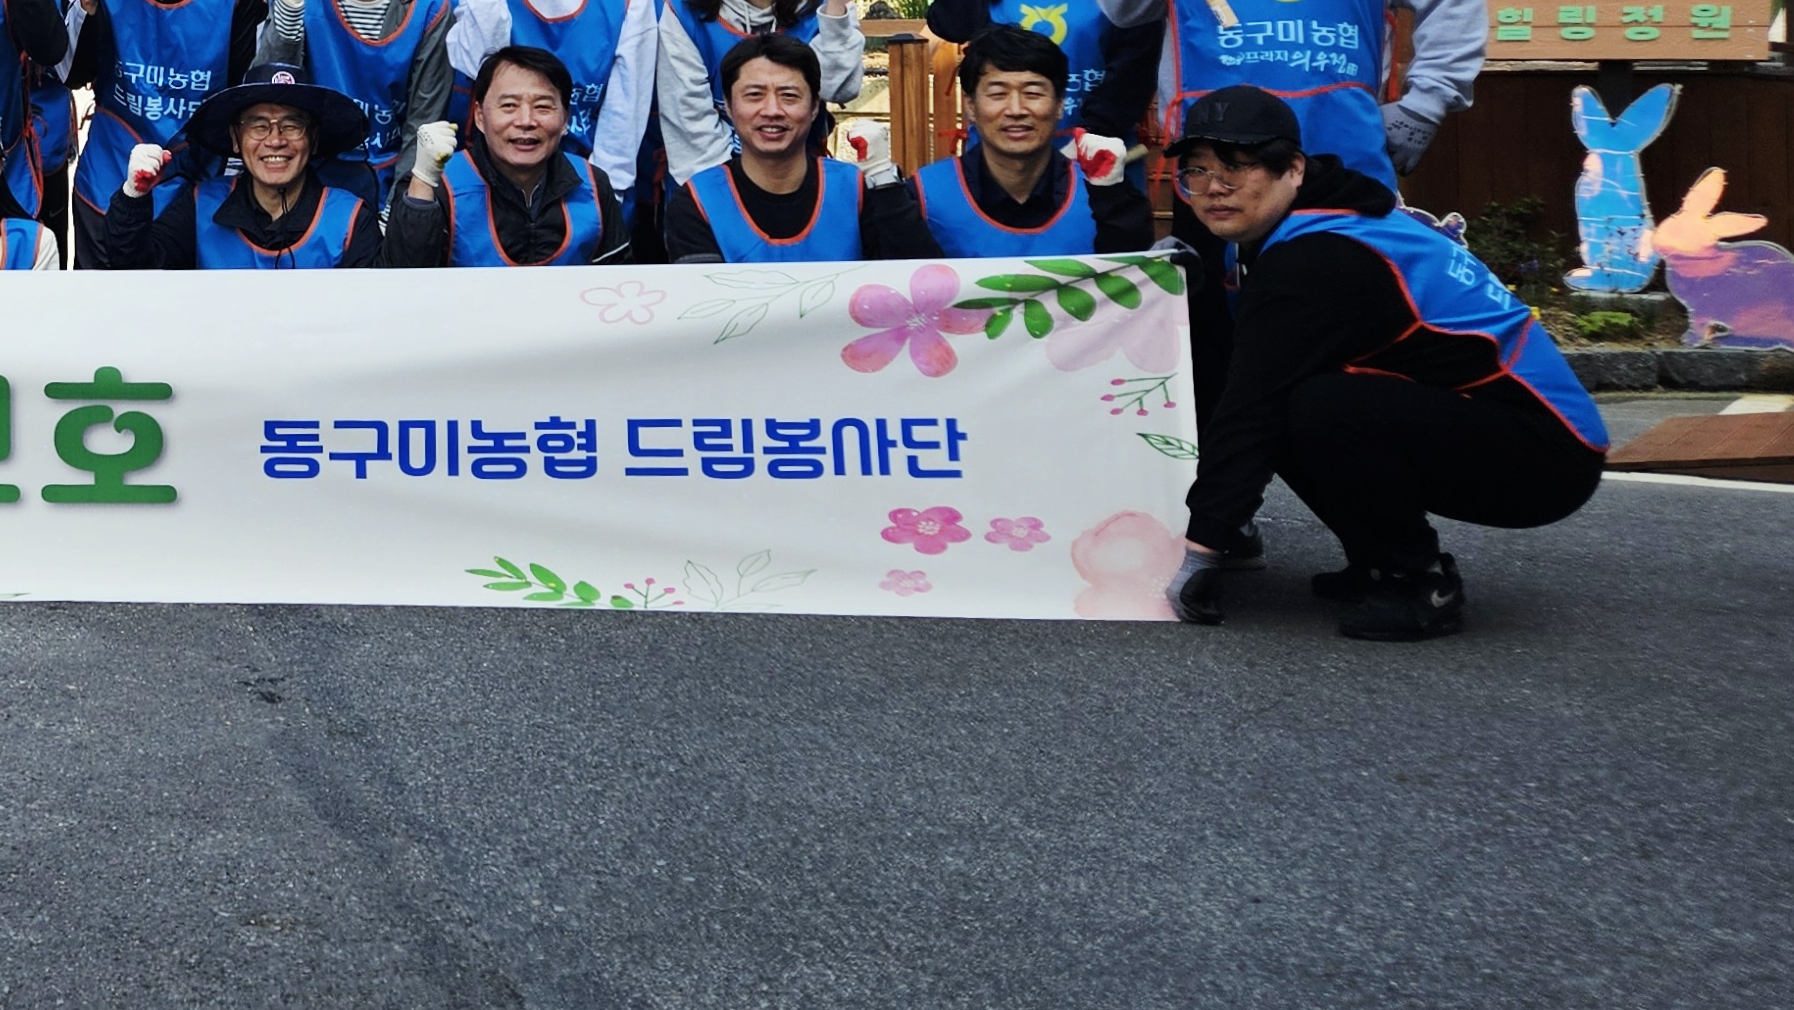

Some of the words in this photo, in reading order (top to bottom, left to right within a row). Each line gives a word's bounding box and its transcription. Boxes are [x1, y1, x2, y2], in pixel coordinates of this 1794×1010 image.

[1311, 20, 1359, 49] 농협
[1496, 4, 1733, 41] 힐링정원
[259, 415, 599, 480] 동구미농협
[624, 416, 968, 480] 드림봉사단
